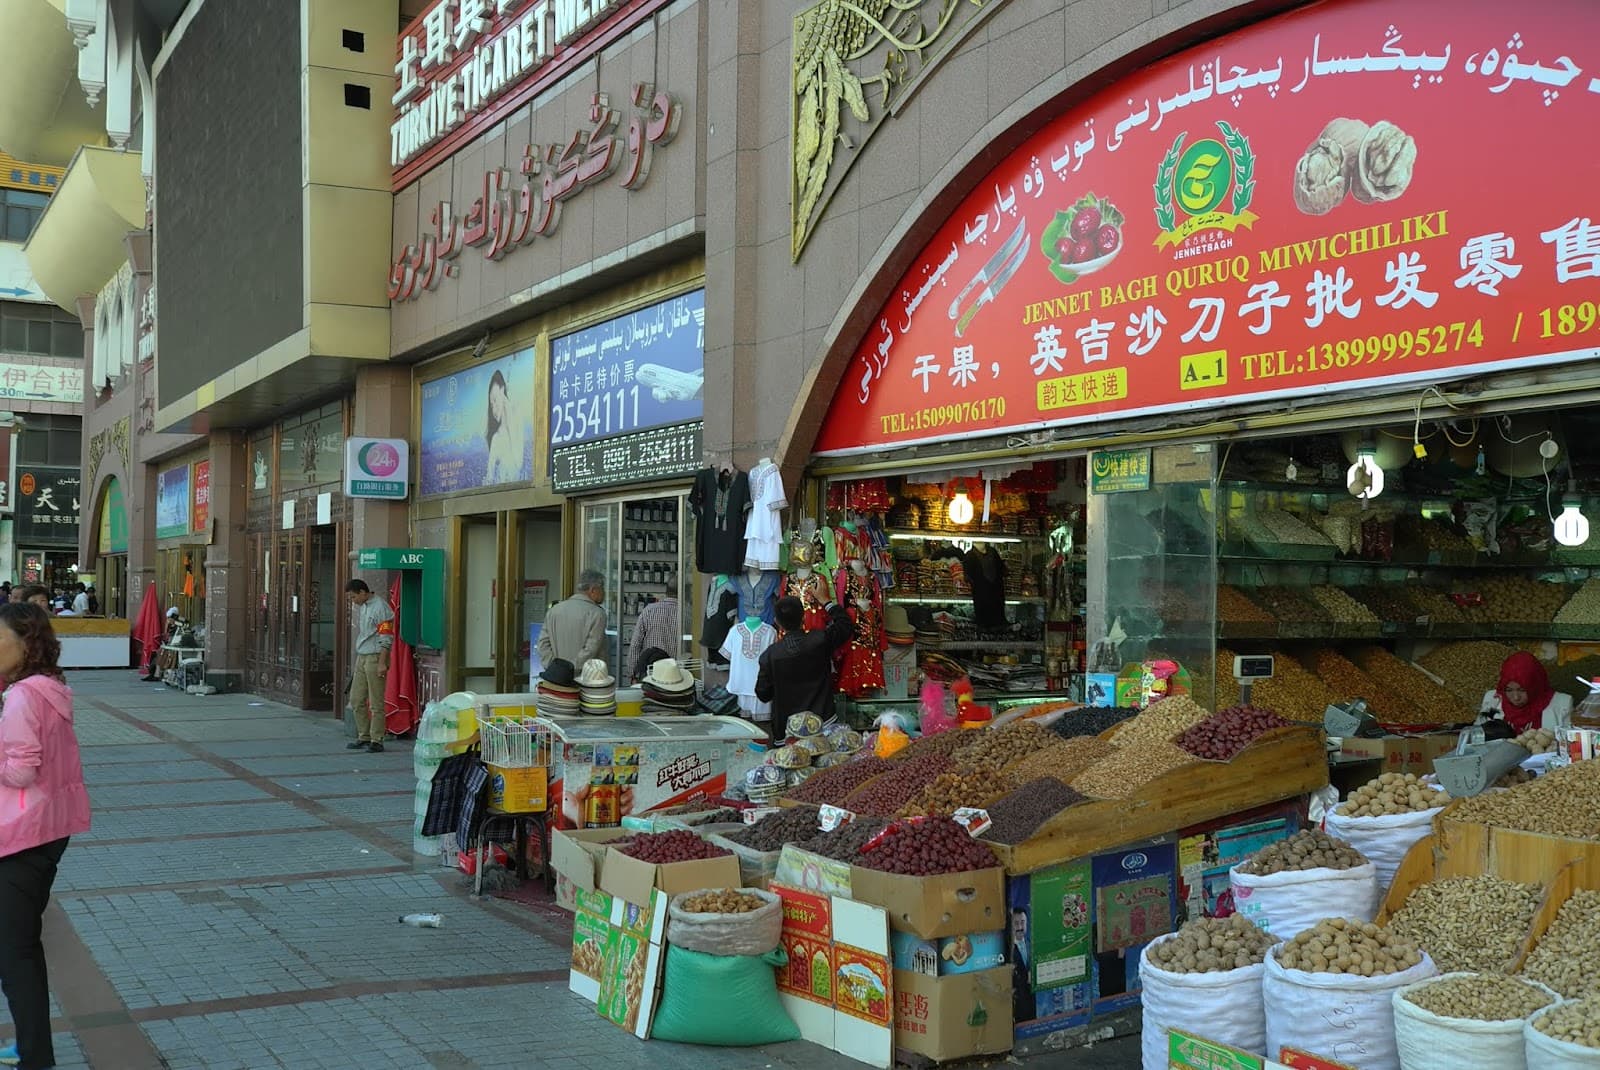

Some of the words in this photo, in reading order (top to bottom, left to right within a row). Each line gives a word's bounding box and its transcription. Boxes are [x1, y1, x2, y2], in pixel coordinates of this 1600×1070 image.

[390, 74, 460, 167] TÜRKİYE
[461, 1, 550, 113] TİCARET
[554, 0, 610, 45] ME
[1049, 117, 1096, 181] توپ
[1023, 156, 1044, 197] ۋە
[964, 183, 1017, 246] پارچە
[1023, 290, 1092, 325] JENNET
[1100, 273, 1157, 308] BAGH
[1165, 256, 1250, 297] QURUQ
[1259, 209, 1450, 270] MIWICHILIKI
[1173, 238, 1233, 261] JENNETBAGH
[1240, 319, 1485, 381] TEL:13899995274
[1539, 301, 1600, 339] 189
[559, 359, 635, 399] 哈卡尼特价票
[1042, 372, 1120, 407] 韵达快递
[551, 384, 639, 444] 2554111
[880, 396, 1006, 434] TEL:15099076170
[567, 453, 595, 478] TEL:
[399, 553, 425, 564] ABC
